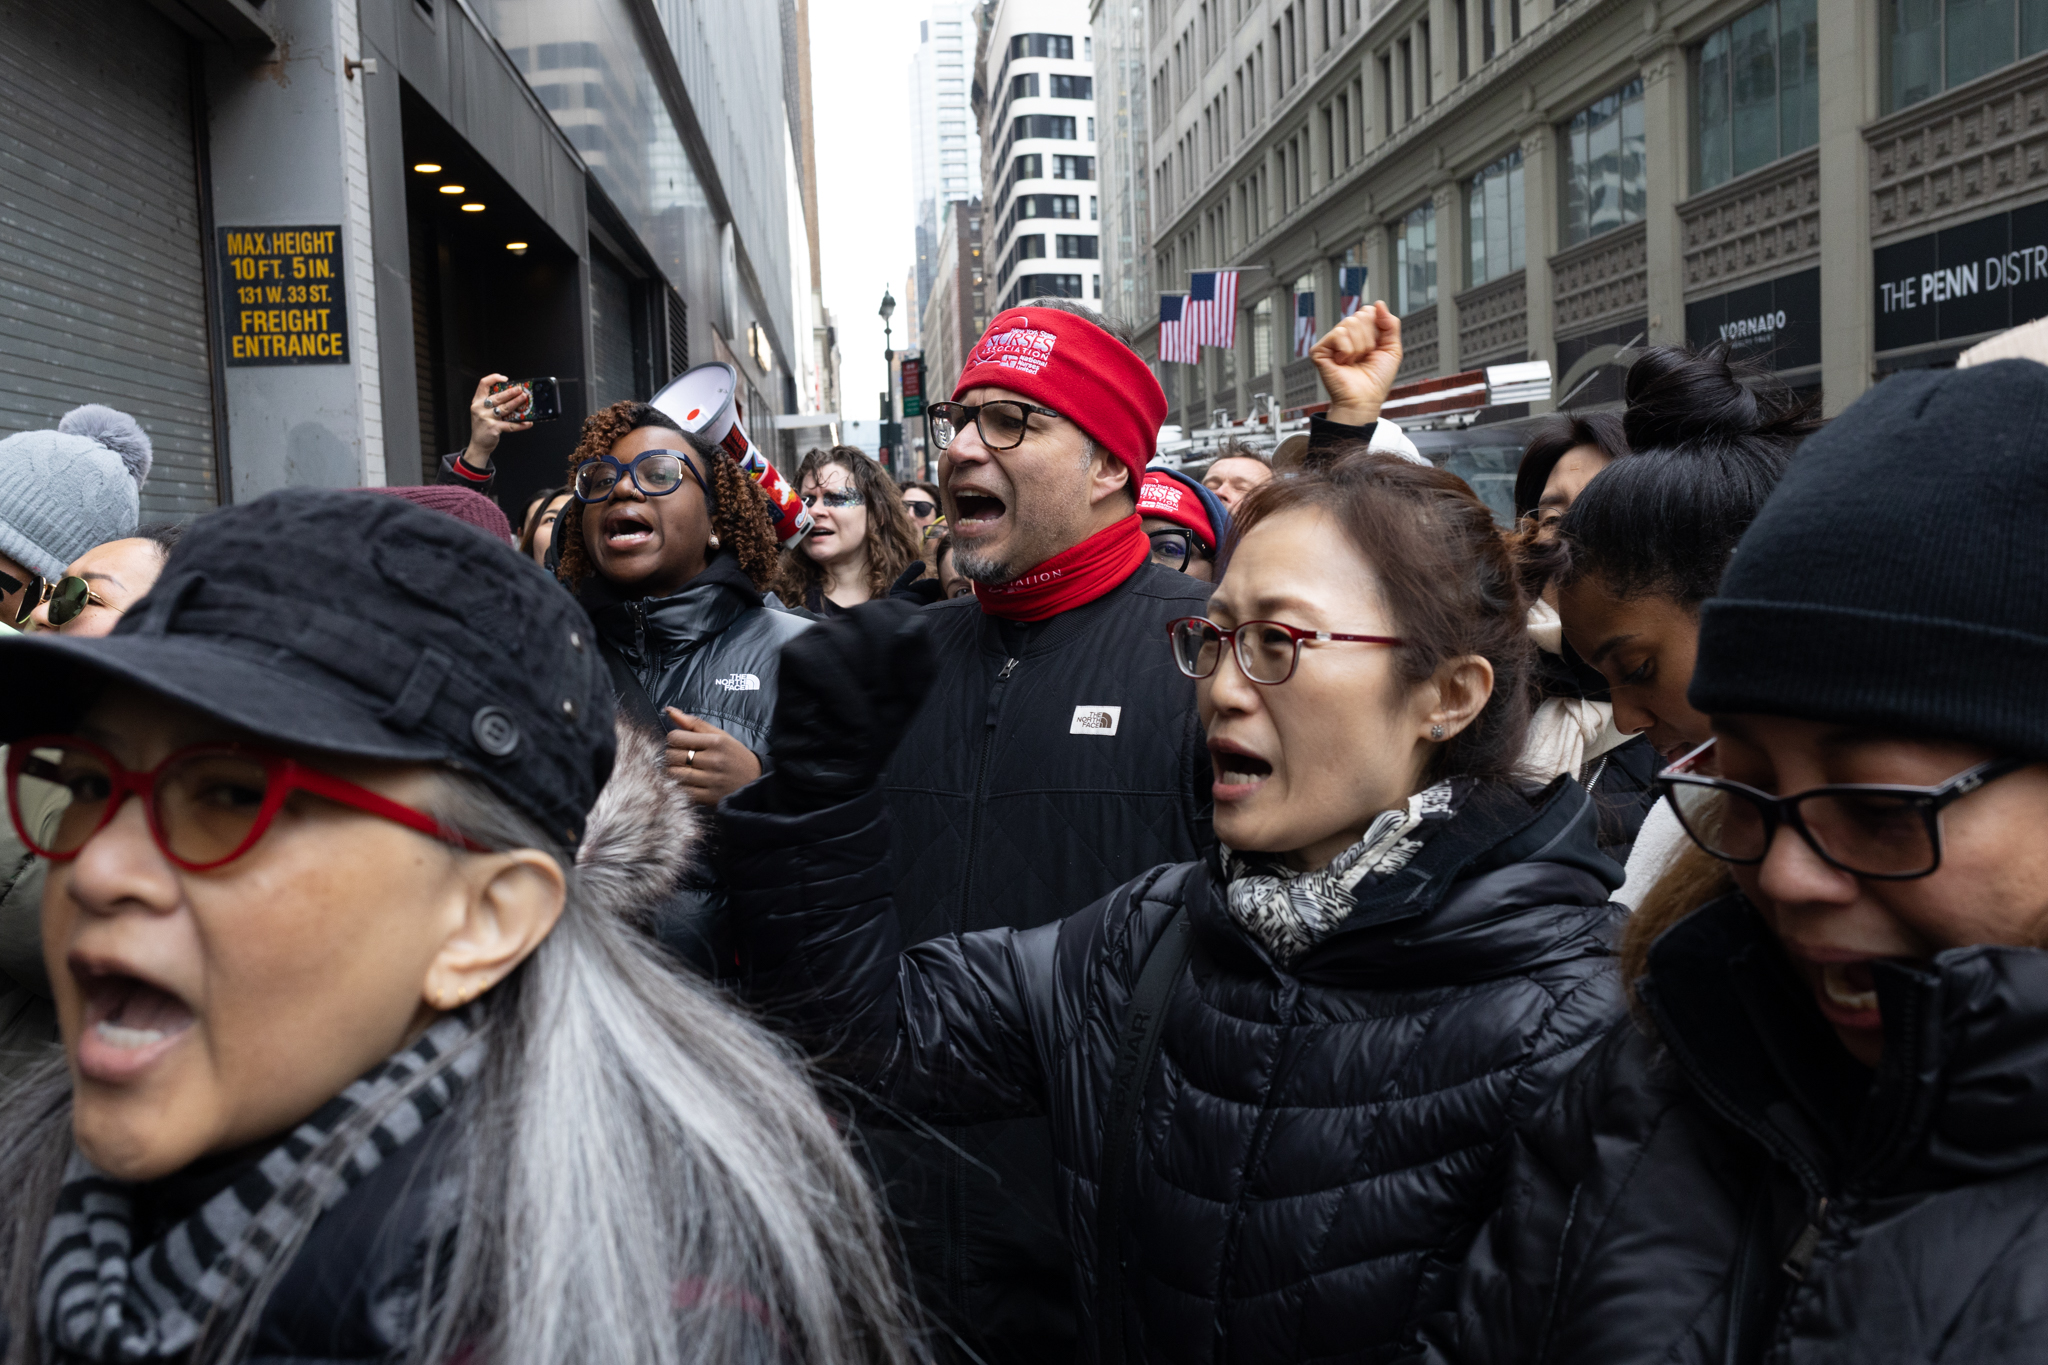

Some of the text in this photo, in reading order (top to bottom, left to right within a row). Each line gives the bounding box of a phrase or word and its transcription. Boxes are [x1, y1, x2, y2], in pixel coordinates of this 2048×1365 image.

[227, 231, 335, 256] MAX. HEIGHT
[230, 256, 335, 280] 10 FT. 5 IN.
[1880, 244, 2048, 314] THE PENN DISTR
[237, 284, 332, 304] 131 W. 33 ST.
[240, 309, 330, 333] FREIGHT
[1719, 310, 1786, 343] VORNADO
[232, 333, 343, 358] ENTRANCE
[982, 345, 1049, 361] ASSOCIATION
[715, 678, 746, 686] NORTH
